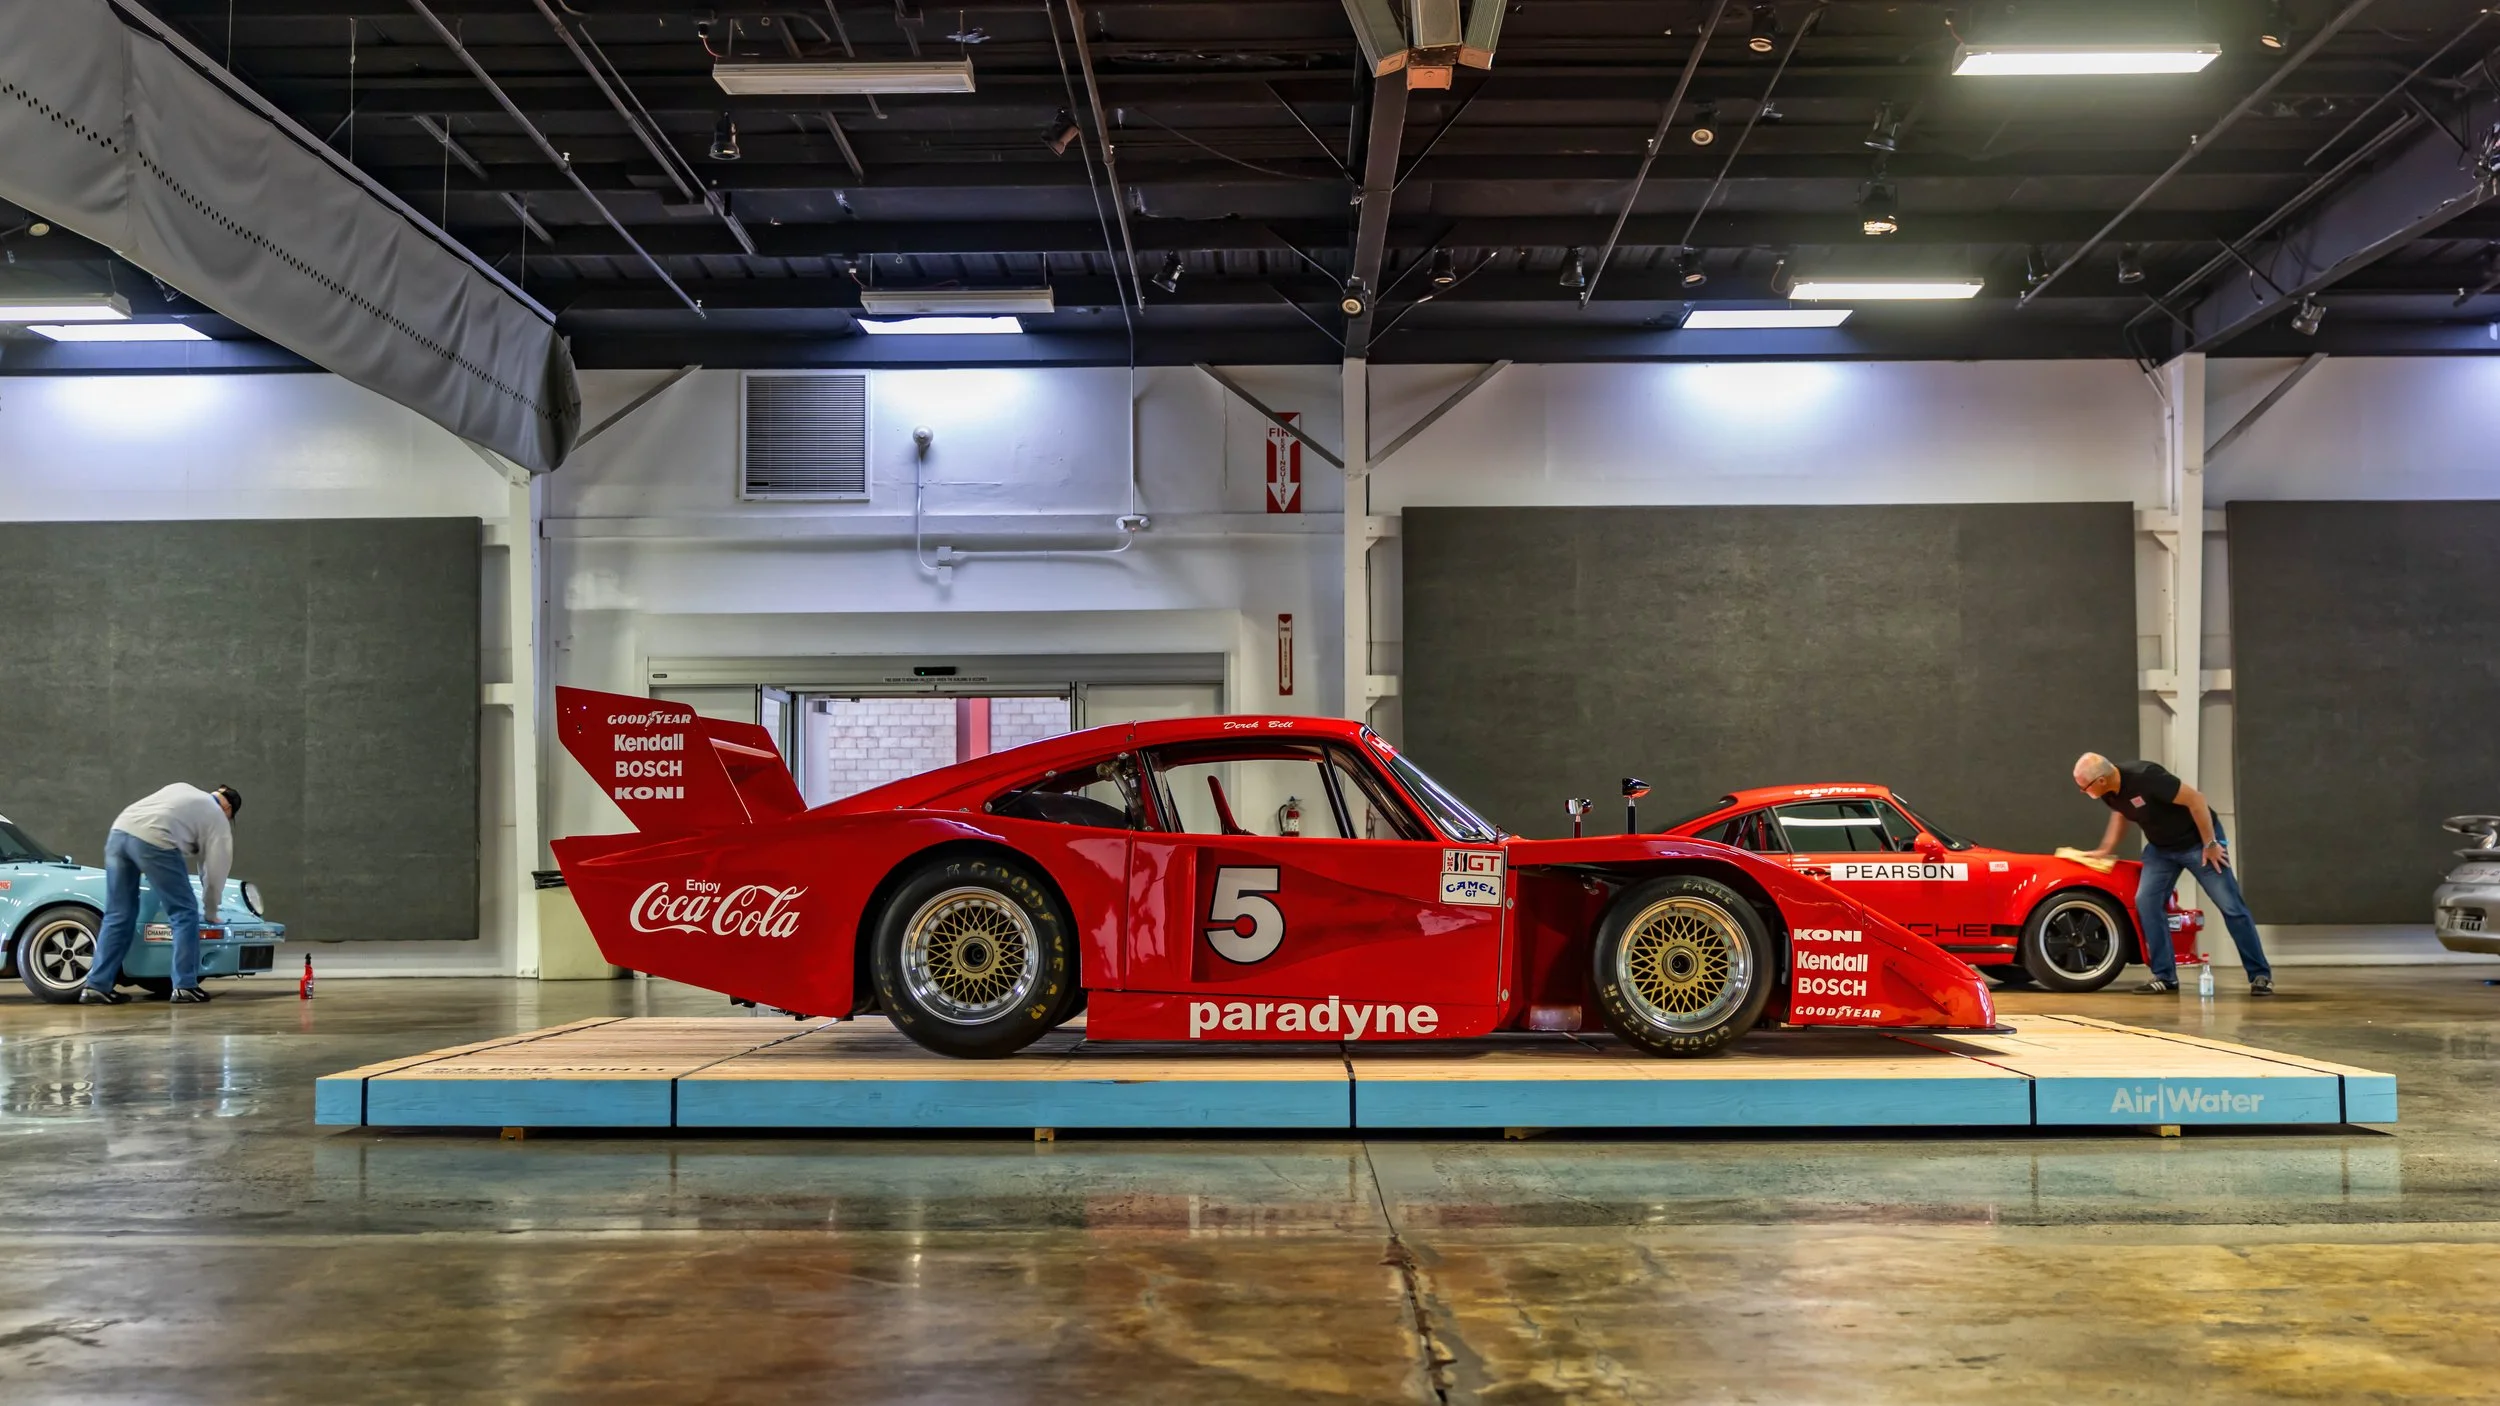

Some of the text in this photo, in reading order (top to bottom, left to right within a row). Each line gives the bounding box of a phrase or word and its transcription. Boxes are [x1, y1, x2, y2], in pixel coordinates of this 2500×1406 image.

[1269, 427, 1293, 438] FIR
[607, 711, 692, 727] GOODYEAR
[1223, 720, 1294, 730] Derek Bell
[614, 733, 684, 752] Kendall
[615, 760, 683, 777] BOSCH
[614, 786, 684, 800] KONI
[1468, 855, 1500, 872] GT
[1846, 865, 1954, 879] PEARSON
[686, 879, 721, 894] Enjoy
[1446, 881, 1497, 896] CAMEL
[1465, 889, 1477, 897] GT
[629, 881, 809, 938] Coca-Cola
[1202, 865, 1287, 965] 5
[147, 929, 174, 937] CHAMPIO
[1793, 928, 1862, 943] KONI
[1796, 950, 1869, 972] Kendall
[1797, 977, 1867, 997] BOSCH
[1189, 995, 1439, 1041] paradyne
[1795, 1005, 1881, 1019] GOODYEAR
